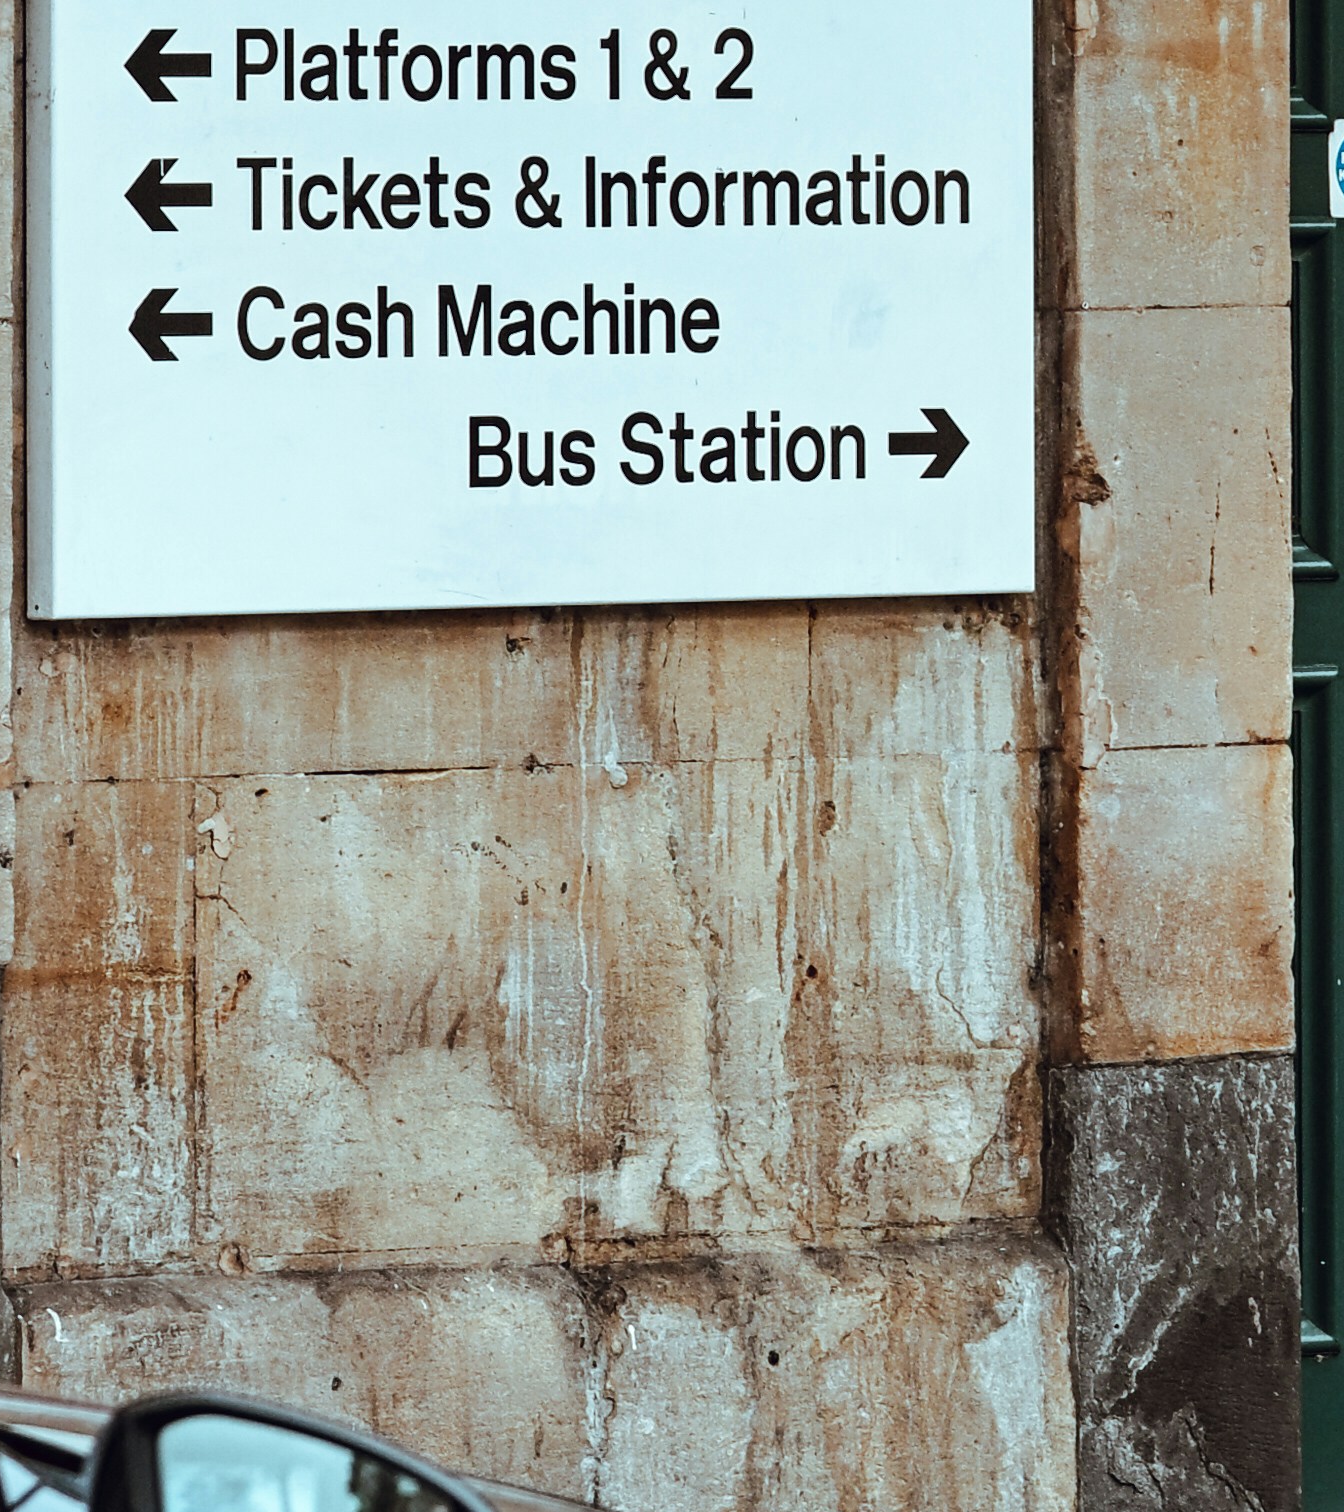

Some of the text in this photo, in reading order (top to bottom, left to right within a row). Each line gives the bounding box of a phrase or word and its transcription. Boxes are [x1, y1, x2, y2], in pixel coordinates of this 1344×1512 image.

[236, 27, 754, 102] Platforms 1 & 2
[236, 153, 970, 231] Tickets & Information
[237, 282, 720, 362] Cash Machine
[469, 410, 866, 489] Bus Station
